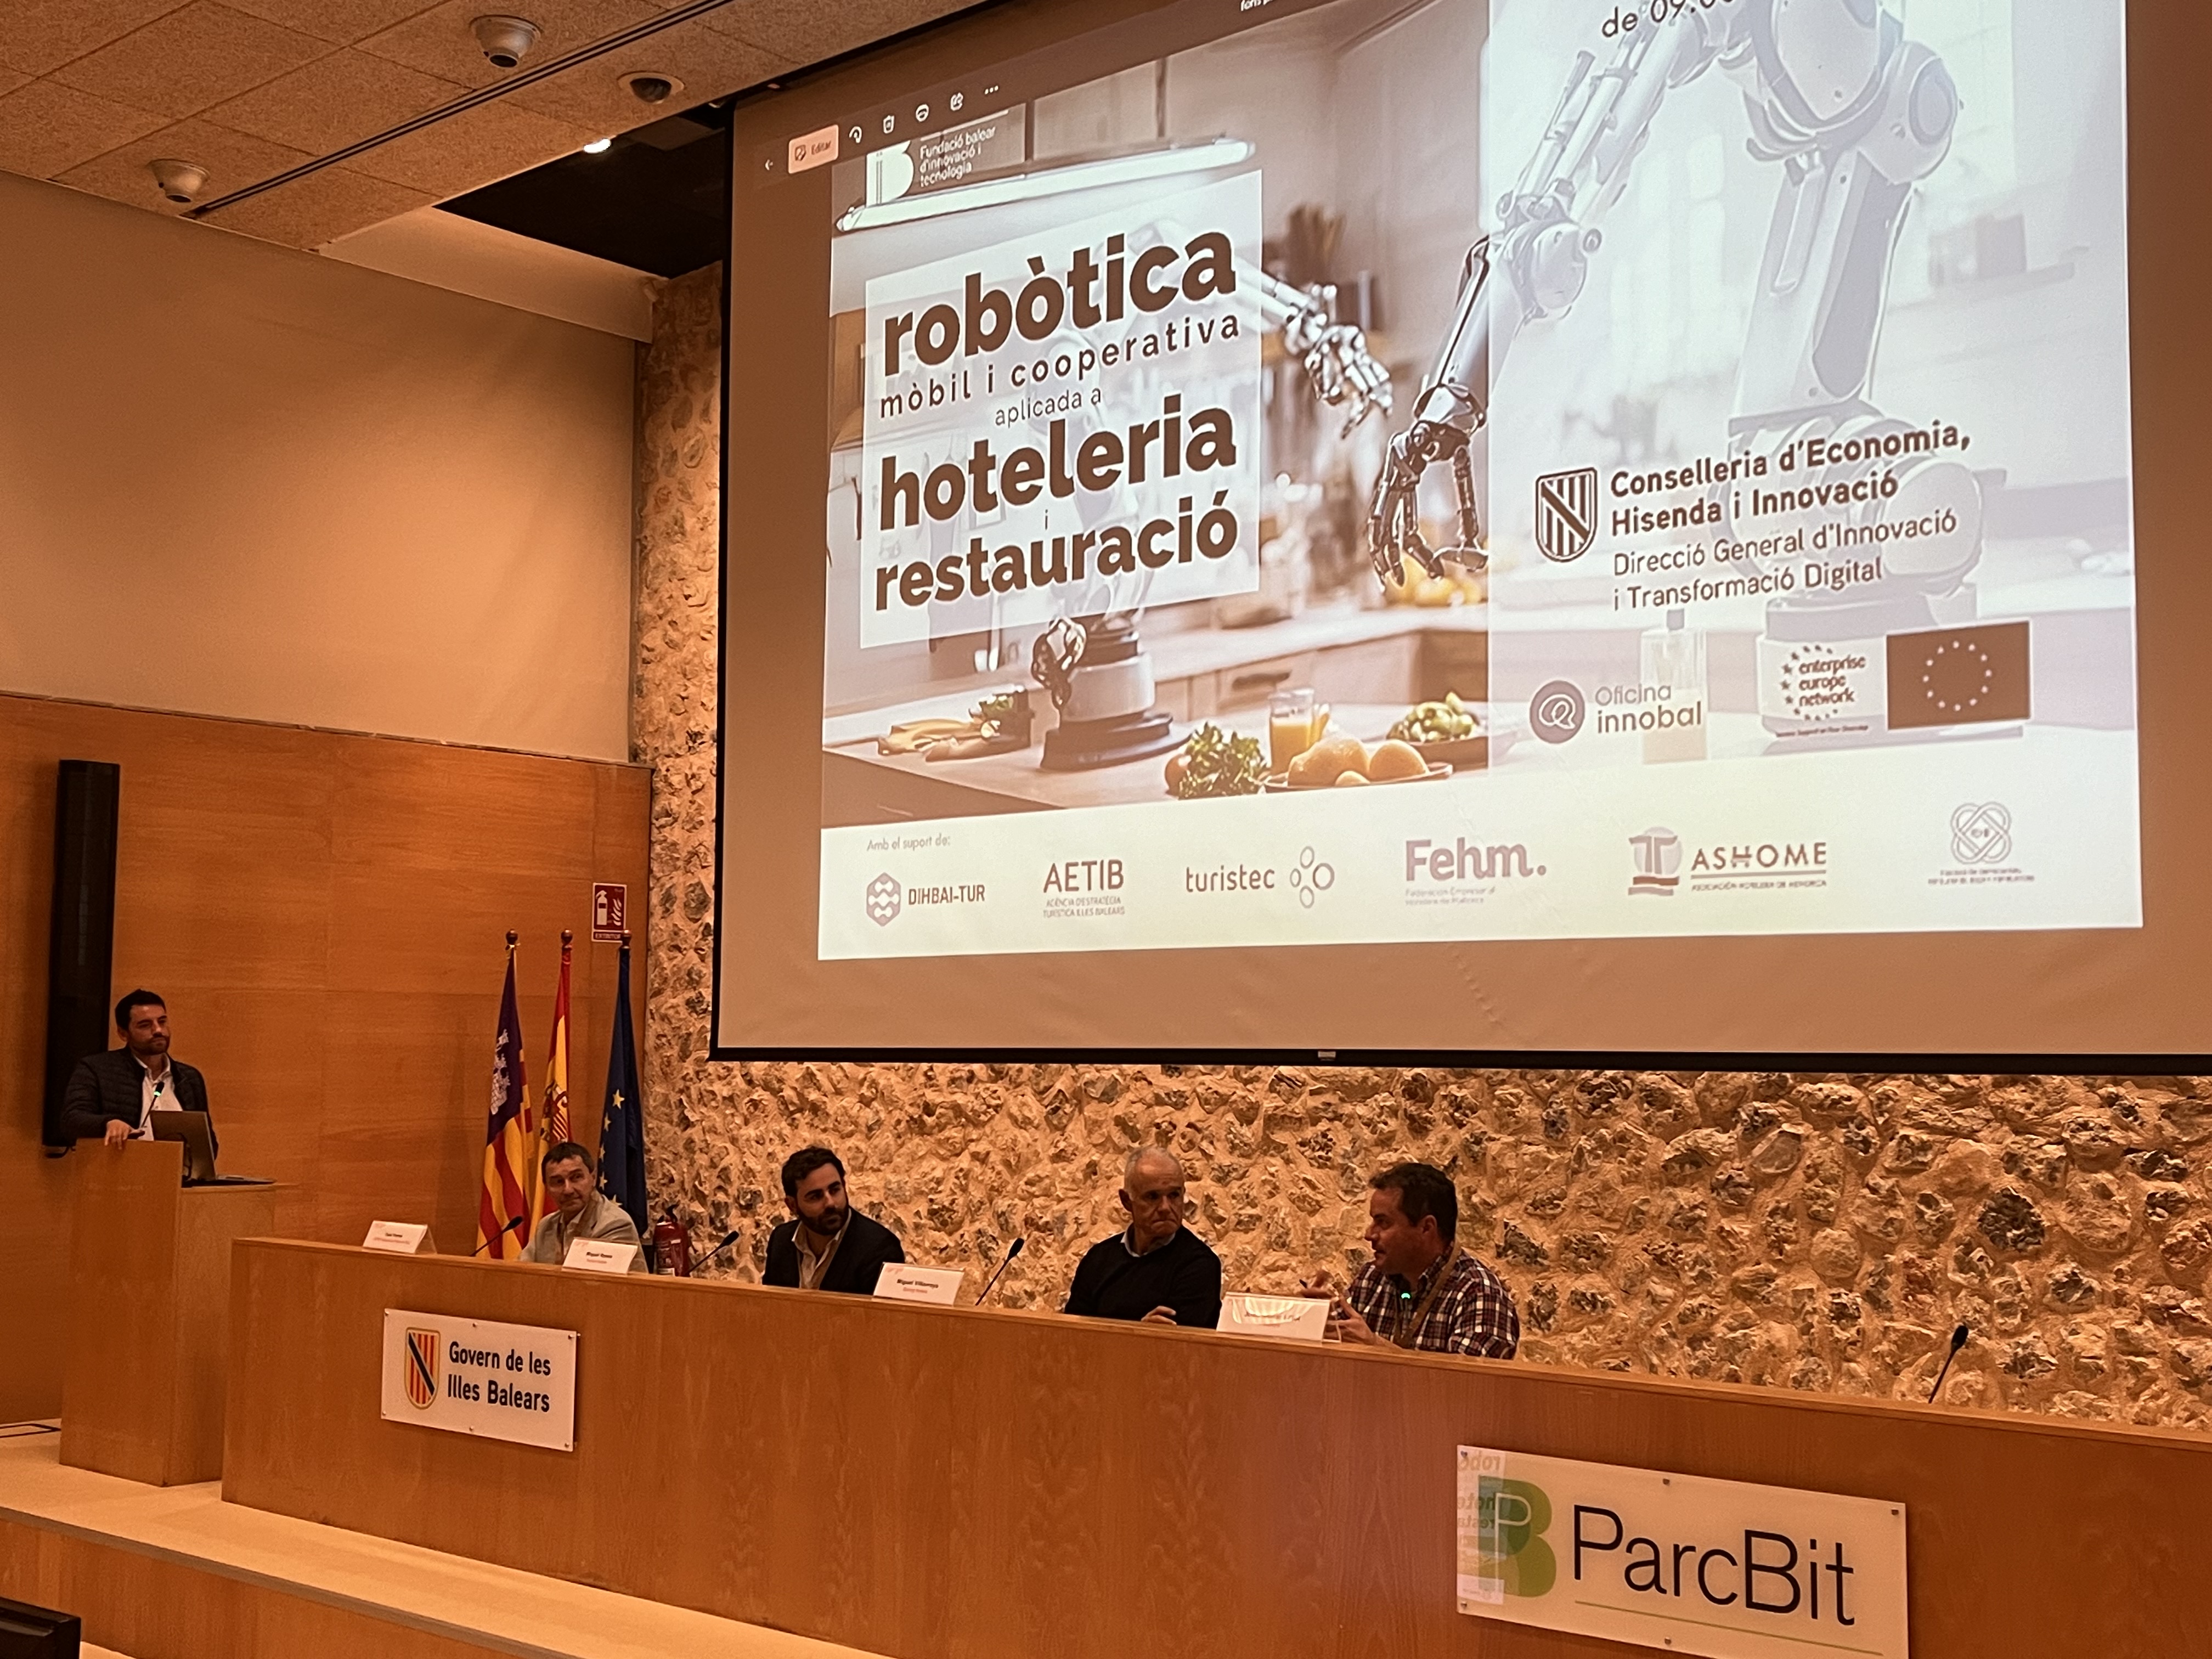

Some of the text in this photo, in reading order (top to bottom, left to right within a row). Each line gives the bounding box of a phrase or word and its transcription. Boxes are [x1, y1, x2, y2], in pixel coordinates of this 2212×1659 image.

[1602, 0, 1734, 37] de 09.
[811, 140, 832, 155] Editar
[919, 126, 996, 160] Fundació balear
[920, 161, 972, 188] tecnologia
[884, 232, 1236, 377] robòtica
[880, 314, 1239, 419] mòbil i cooperativa
[995, 387, 1102, 428] aplicada a
[880, 393, 1237, 531] hoteleria
[1611, 420, 1971, 498] Conselleria d'Economia,
[1044, 509, 1049, 531] i
[1612, 473, 1899, 536] Hisenda i Innovació
[876, 489, 1238, 611] restauració
[1615, 507, 1957, 576] Direcció General d'Innovació
[1613, 557, 1883, 610] i Transformació Digital
[1798, 654, 1866, 675] enterprise
[1595, 684, 1672, 707] Oficina
[1798, 675, 1847, 691] europe
[1799, 687, 1855, 707] network
[1597, 701, 1702, 734] innobal
[866, 838, 889, 851] Amb
[891, 836, 900, 850] el
[903, 836, 932, 851] suport
[1691, 842, 1827, 871] ASHOME
[1043, 859, 1124, 893] AETIB
[1186, 864, 1274, 892] turistec
[908, 884, 985, 905] DIHBAI-TUR
[449, 1341, 551, 1375] Govern de les
[448, 1374, 549, 1412] Illes Balears
[1573, 1505, 1854, 1626] ParcBit
